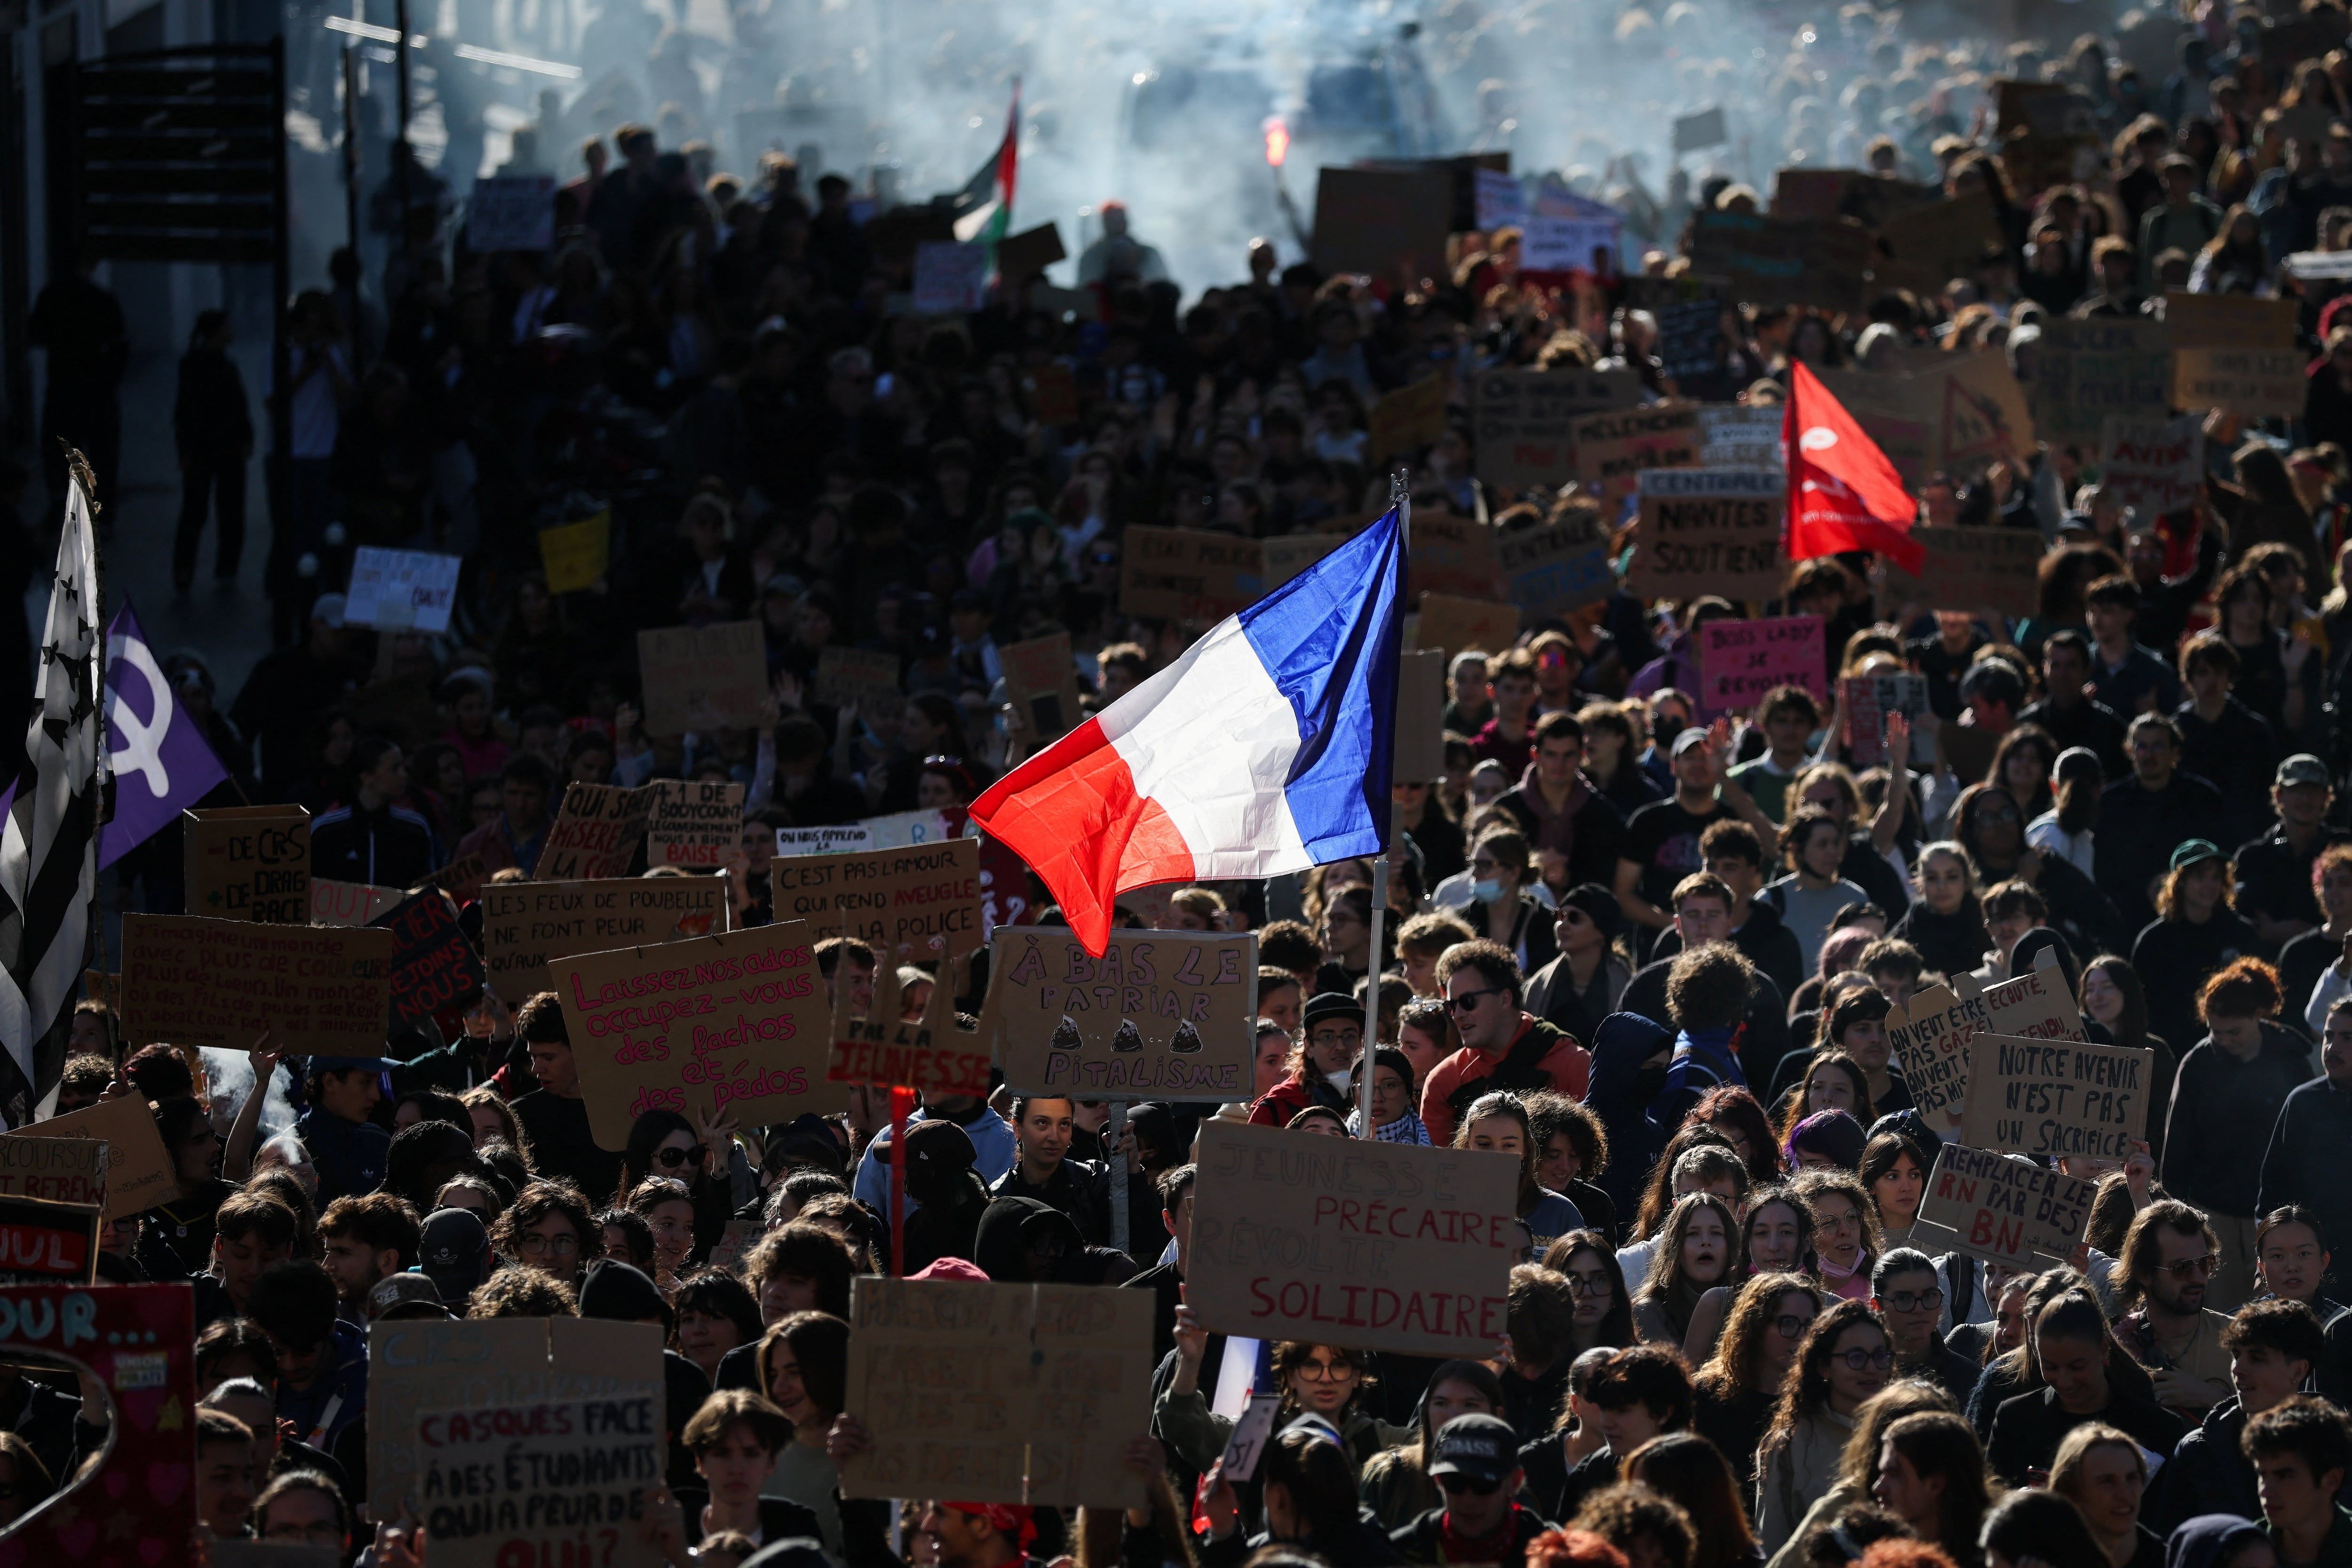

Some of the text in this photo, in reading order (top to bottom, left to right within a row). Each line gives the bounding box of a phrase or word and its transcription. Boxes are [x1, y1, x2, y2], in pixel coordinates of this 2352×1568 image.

[1658, 500, 1770, 532] NANTES
[660, 804, 742, 820] BODYCOUNT
[701, 784, 727, 803] DE
[230, 836, 254, 861] DE
[654, 835, 683, 844] NOUS
[781, 833, 795, 843] ON
[781, 851, 959, 890] C'EST PAS L'AMOUR
[227, 883, 250, 909] DE
[254, 871, 305, 896] DRAG
[488, 890, 715, 916] LES FEUX DE POUBELLE
[795, 878, 976, 914] QUI REND AVEUGLE
[495, 917, 645, 946] NE FONT PEUR
[858, 920, 884, 941] LA
[897, 907, 973, 942] POLICE
[491, 952, 547, 972] QU'AUX
[571, 967, 696, 1011] Laissez
[743, 945, 811, 974] ados
[1009, 933, 1241, 987] À BAS LE
[185, 964, 211, 986] de
[307, 981, 379, 1003] monde
[397, 962, 473, 1023] NOUS
[155, 988, 185, 1006] des
[231, 996, 254, 1012] de
[261, 1002, 311, 1020] putes
[318, 1001, 343, 1017] de
[240, 1016, 271, 1032] pas
[285, 1017, 309, 1032] des
[615, 1013, 796, 1066] des fachos
[1889, 1026, 1911, 1052] ON
[1908, 1013, 1945, 1044] VEUT
[1947, 996, 1986, 1028] ÊTRE
[681, 1057, 725, 1085] et
[826, 1041, 992, 1090] JEUNESSE
[1898, 1042, 1936, 1073] PAS
[1906, 1071, 1927, 1094] ON
[1926, 1054, 1959, 1084] VEUT
[1998, 1044, 2070, 1077] NOTRE
[629, 1059, 808, 1120] des pédos
[1912, 1086, 1947, 1117] PAS
[2006, 1082, 2130, 1124] N'EST PAS
[1997, 1119, 2024, 1145] UN
[1216, 1142, 1458, 1202] JEUNESSE
[1942, 1145, 2094, 1208] REMPLACER LE
[1315, 1196, 1509, 1249] PRÉCAIRE
[1937, 1172, 2082, 1237] RN PAR DES
[1192, 1216, 1395, 1280] RÉVOLTE
[1969, 1208, 2024, 1255] BN
[1249, 1276, 1507, 1340] SOLIDAIRE
[420, 1404, 573, 1447] CASQUES
[584, 1398, 653, 1436] FACE
[449, 1462, 496, 1498] DES
[498, 1498, 518, 1531] A
[527, 1491, 602, 1528] PEUR
[608, 1488, 644, 1521] DE
